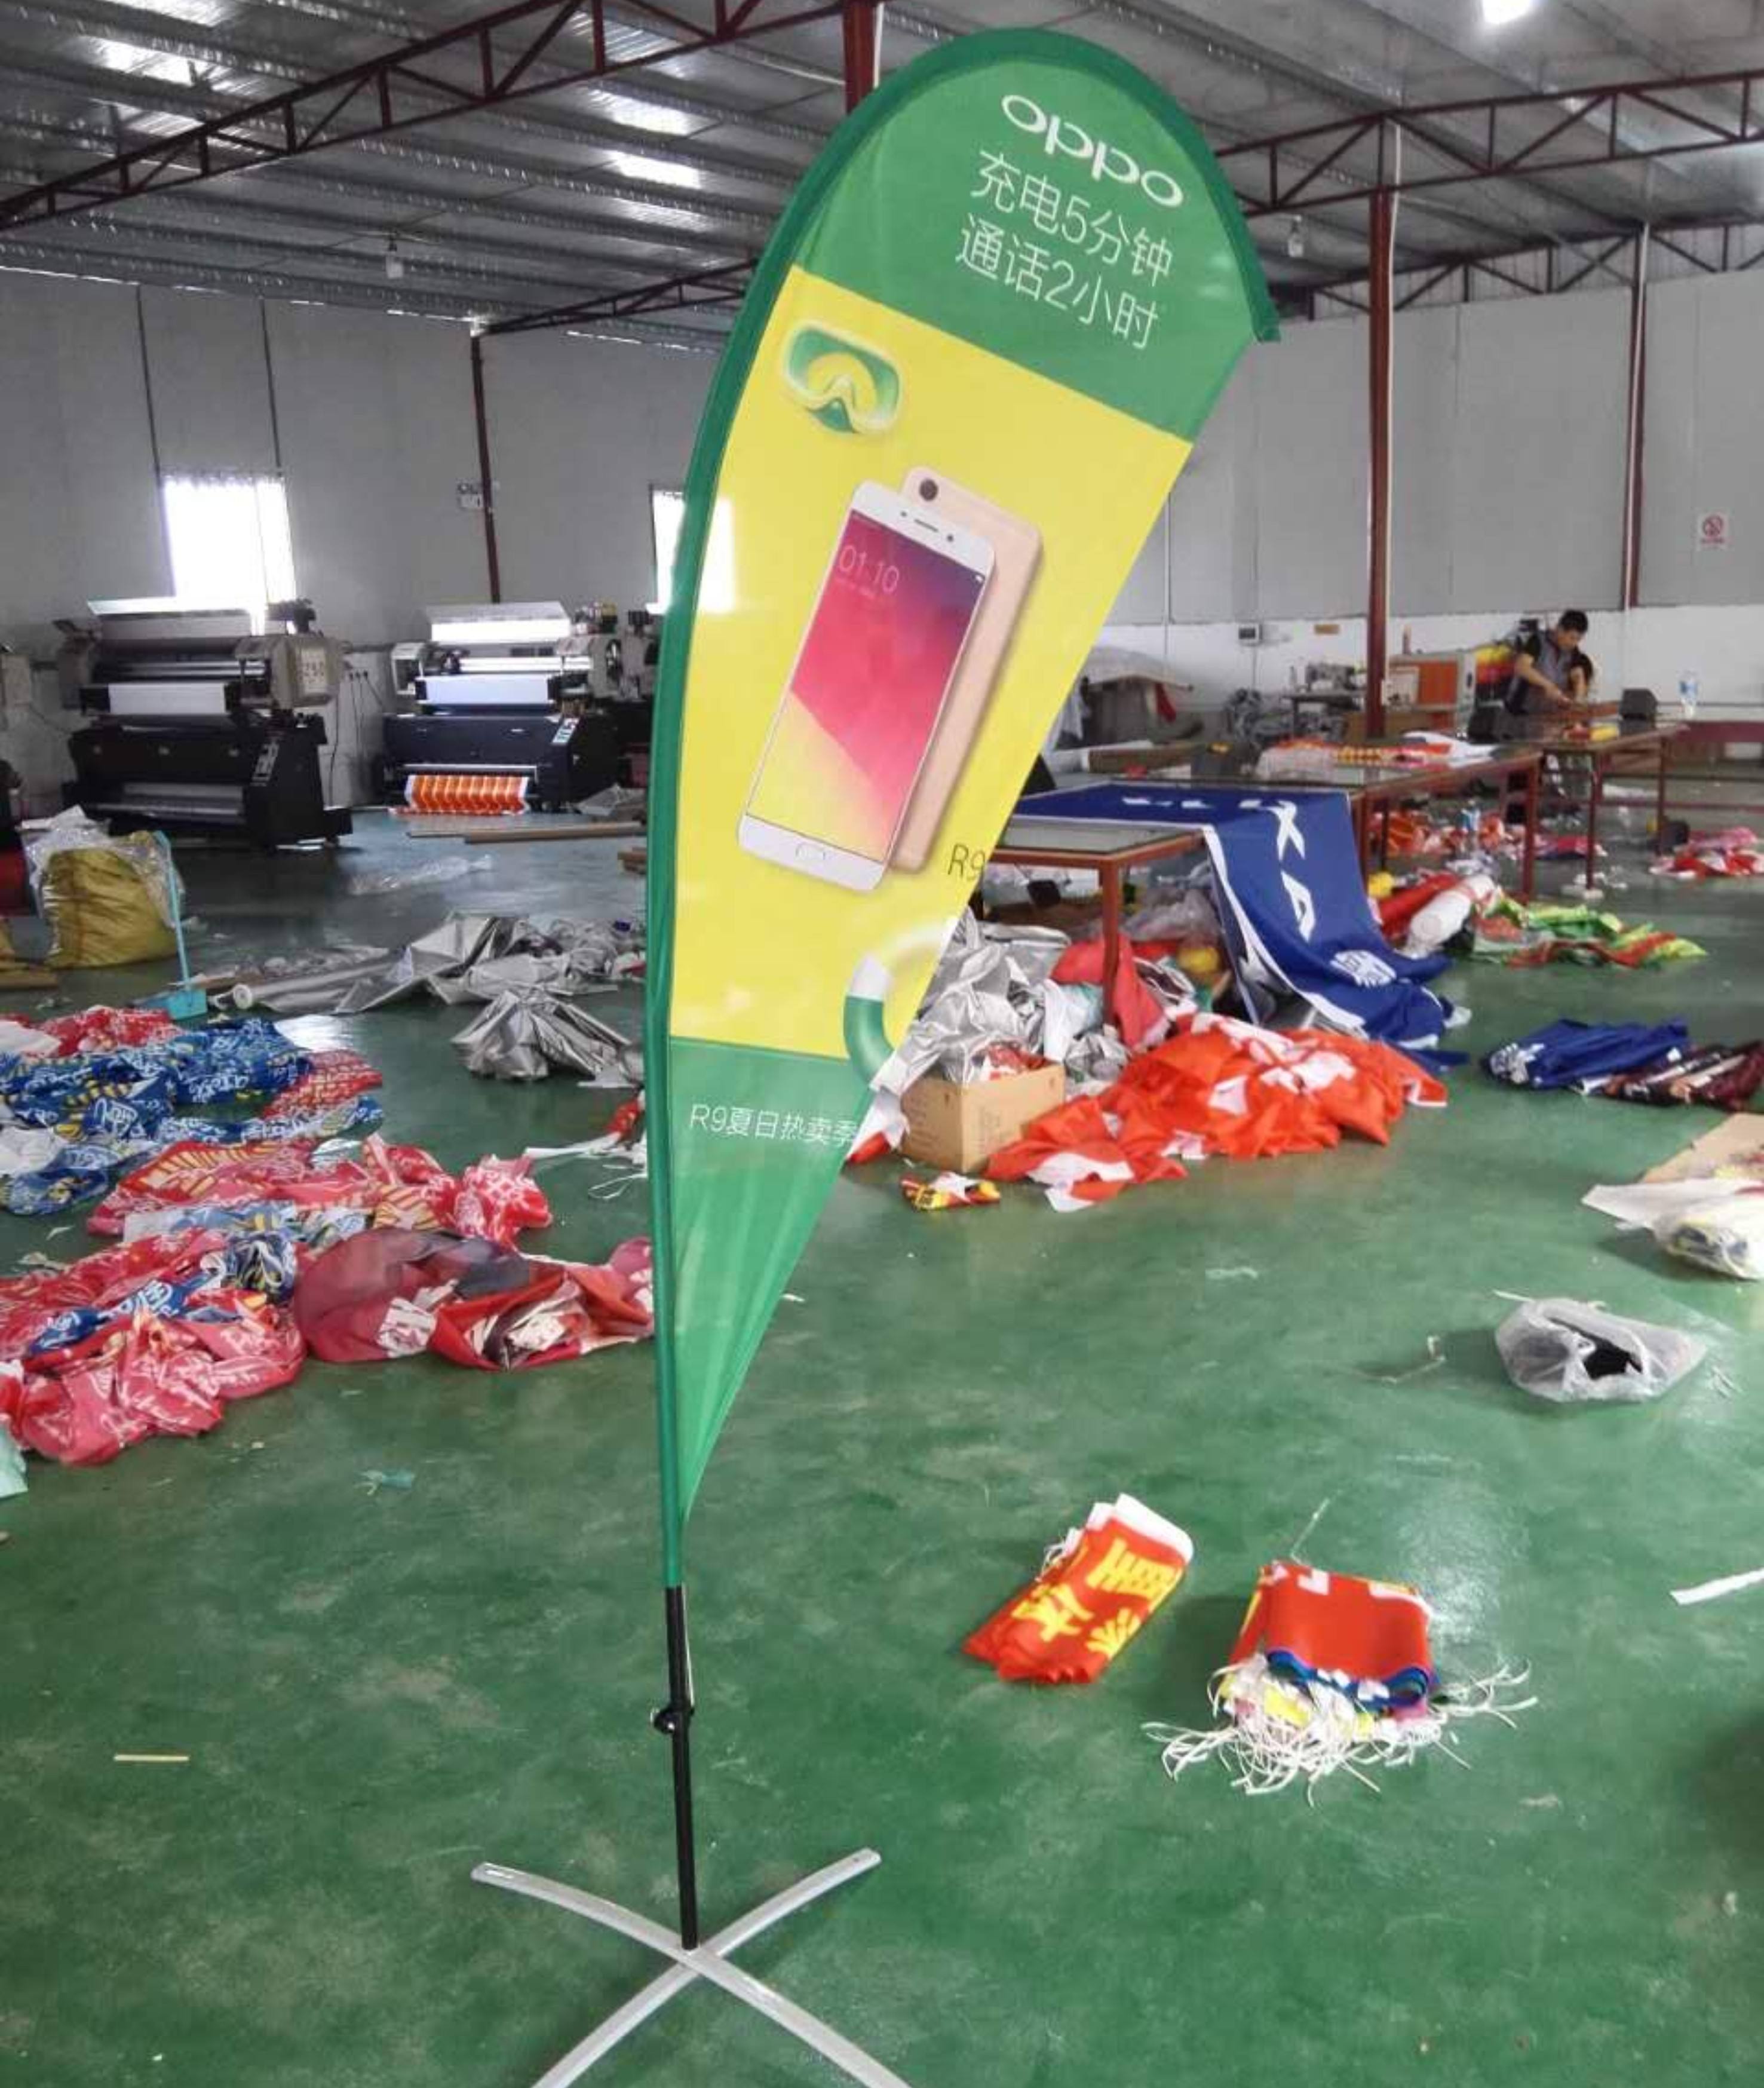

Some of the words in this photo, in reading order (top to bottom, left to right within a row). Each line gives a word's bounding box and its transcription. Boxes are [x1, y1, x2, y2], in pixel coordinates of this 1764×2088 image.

[956, 213, 1158, 349] 通话2小时
[970, 151, 1173, 287] 充电5分钟
[947, 843, 986, 881] R9
